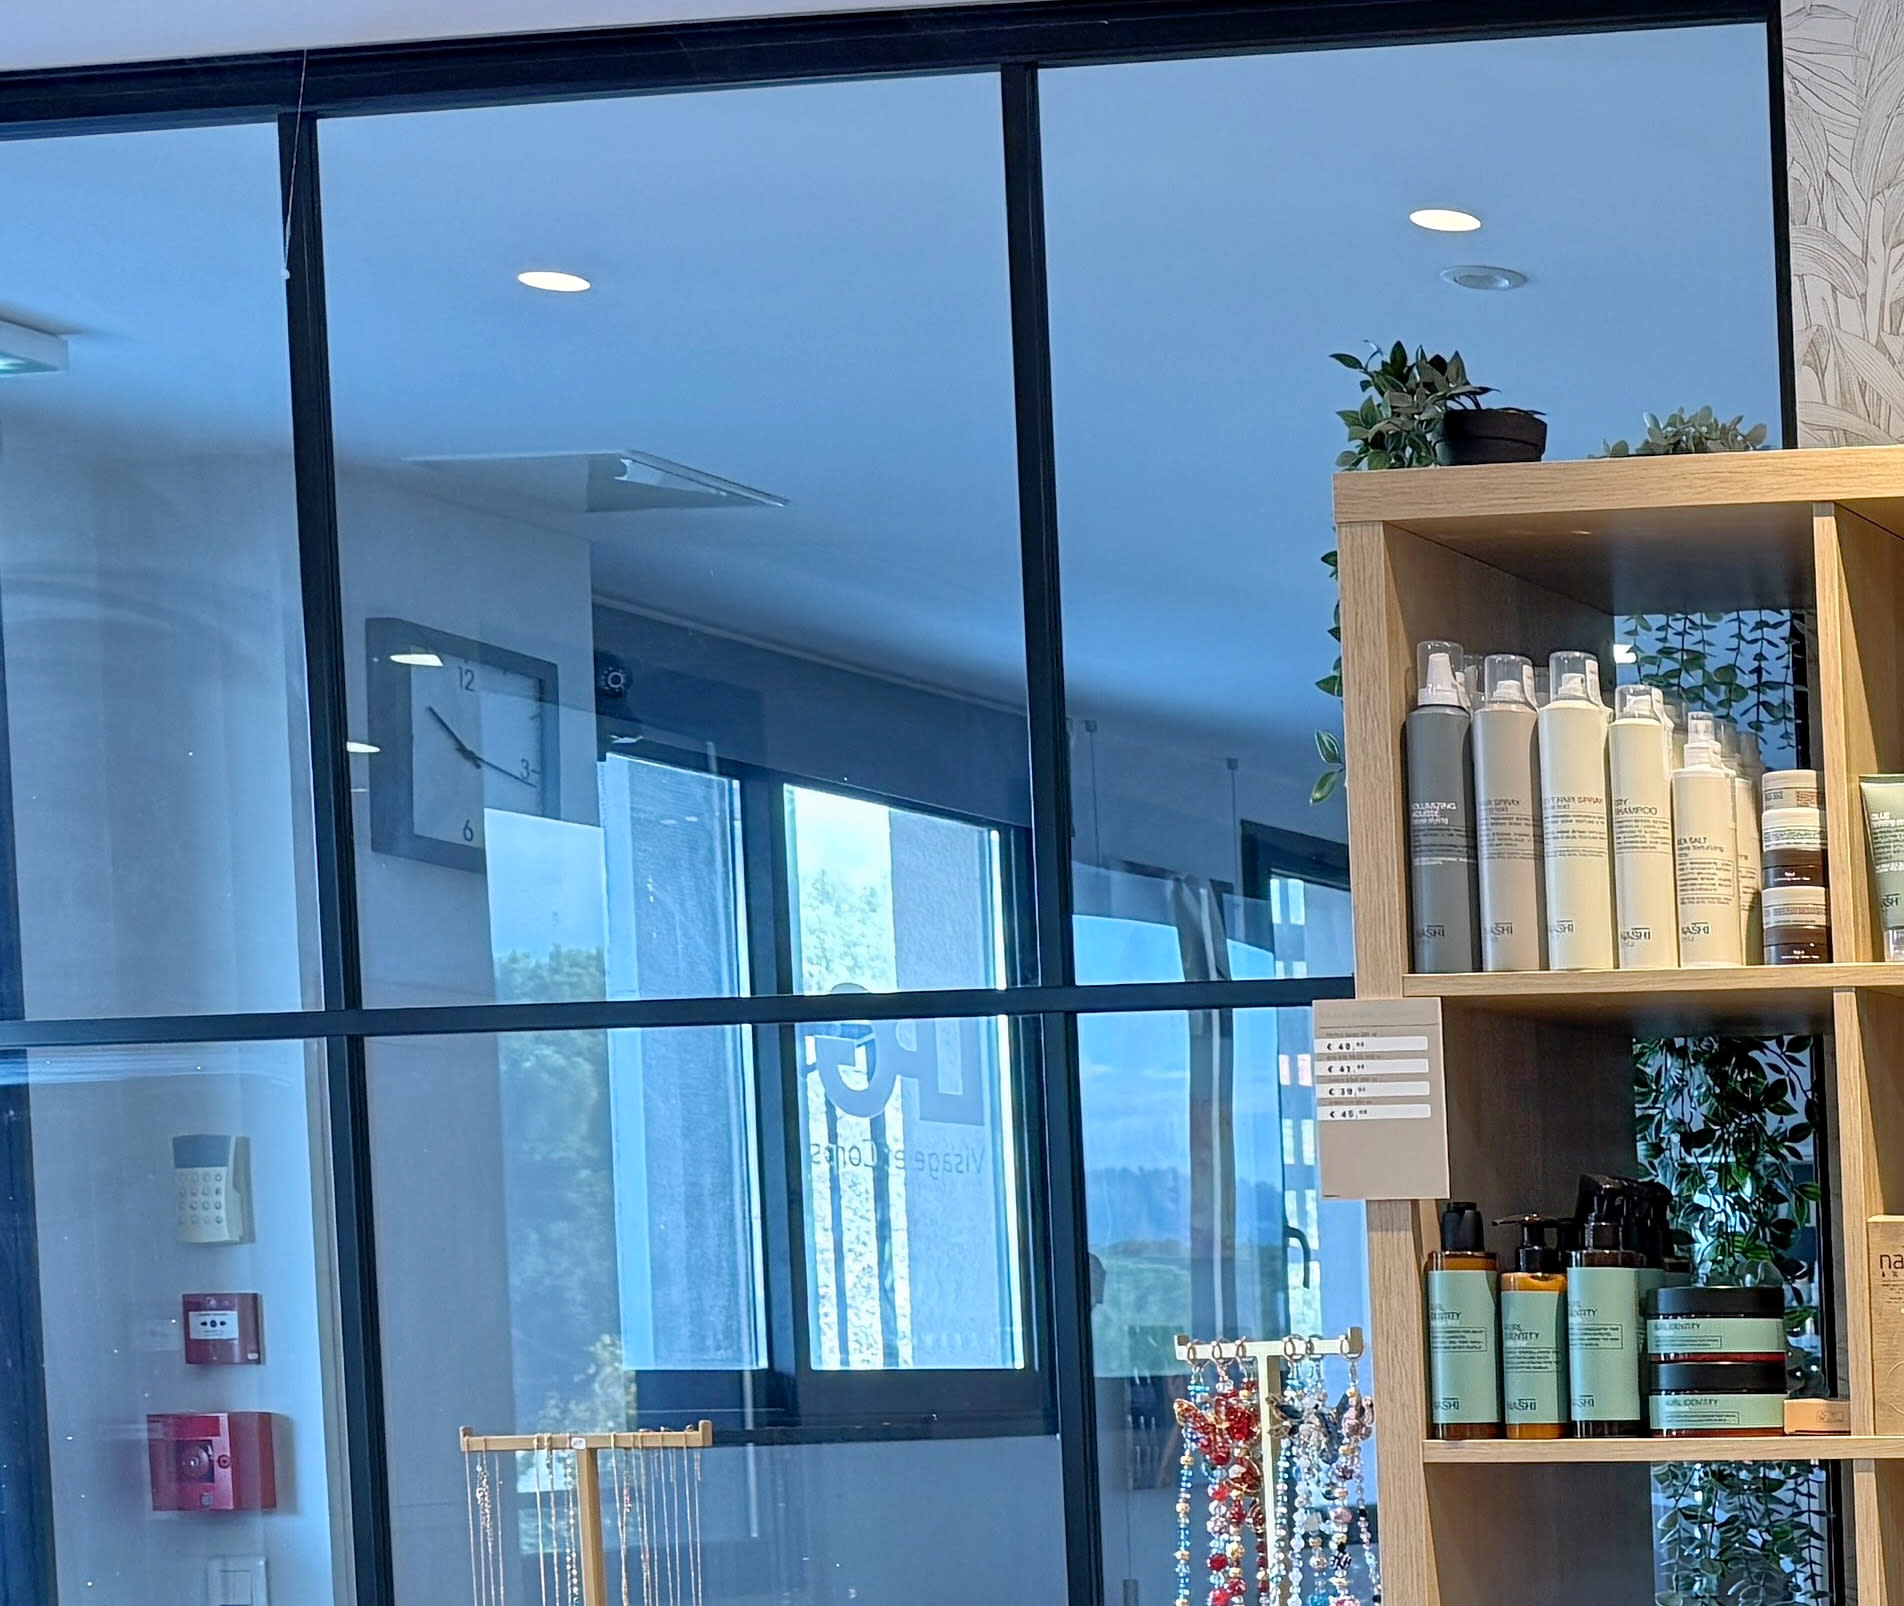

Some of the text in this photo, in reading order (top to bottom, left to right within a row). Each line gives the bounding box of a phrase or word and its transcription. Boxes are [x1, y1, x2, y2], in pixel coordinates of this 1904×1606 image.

[456, 665, 476, 692] 12
[519, 758, 532, 780] 3
[462, 818, 475, 843] 6
